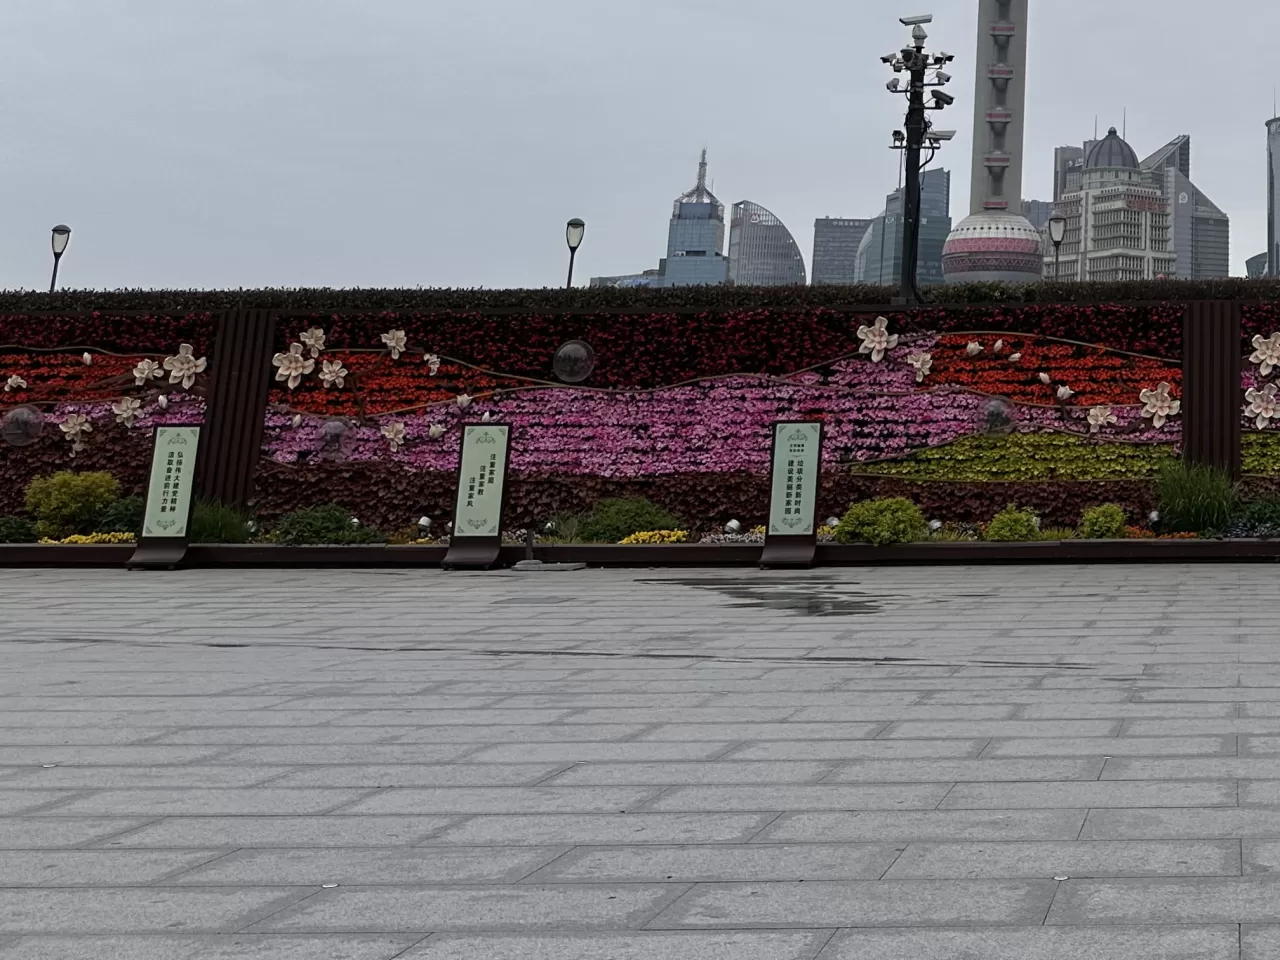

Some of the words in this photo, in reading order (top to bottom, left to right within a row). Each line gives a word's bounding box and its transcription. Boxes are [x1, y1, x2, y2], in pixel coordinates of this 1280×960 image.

[160, 451, 175, 513] 汲取奋进前行力量
[169, 451, 184, 513] 弘扬伟大建党精神
[466, 477, 476, 508] 注重家风
[477, 465, 487, 496] 注重家教
[487, 453, 497, 484] 注重家庭
[784, 459, 795, 515] 建设美丽新家园
[794, 459, 804, 515] 垃圾分类新时尚
